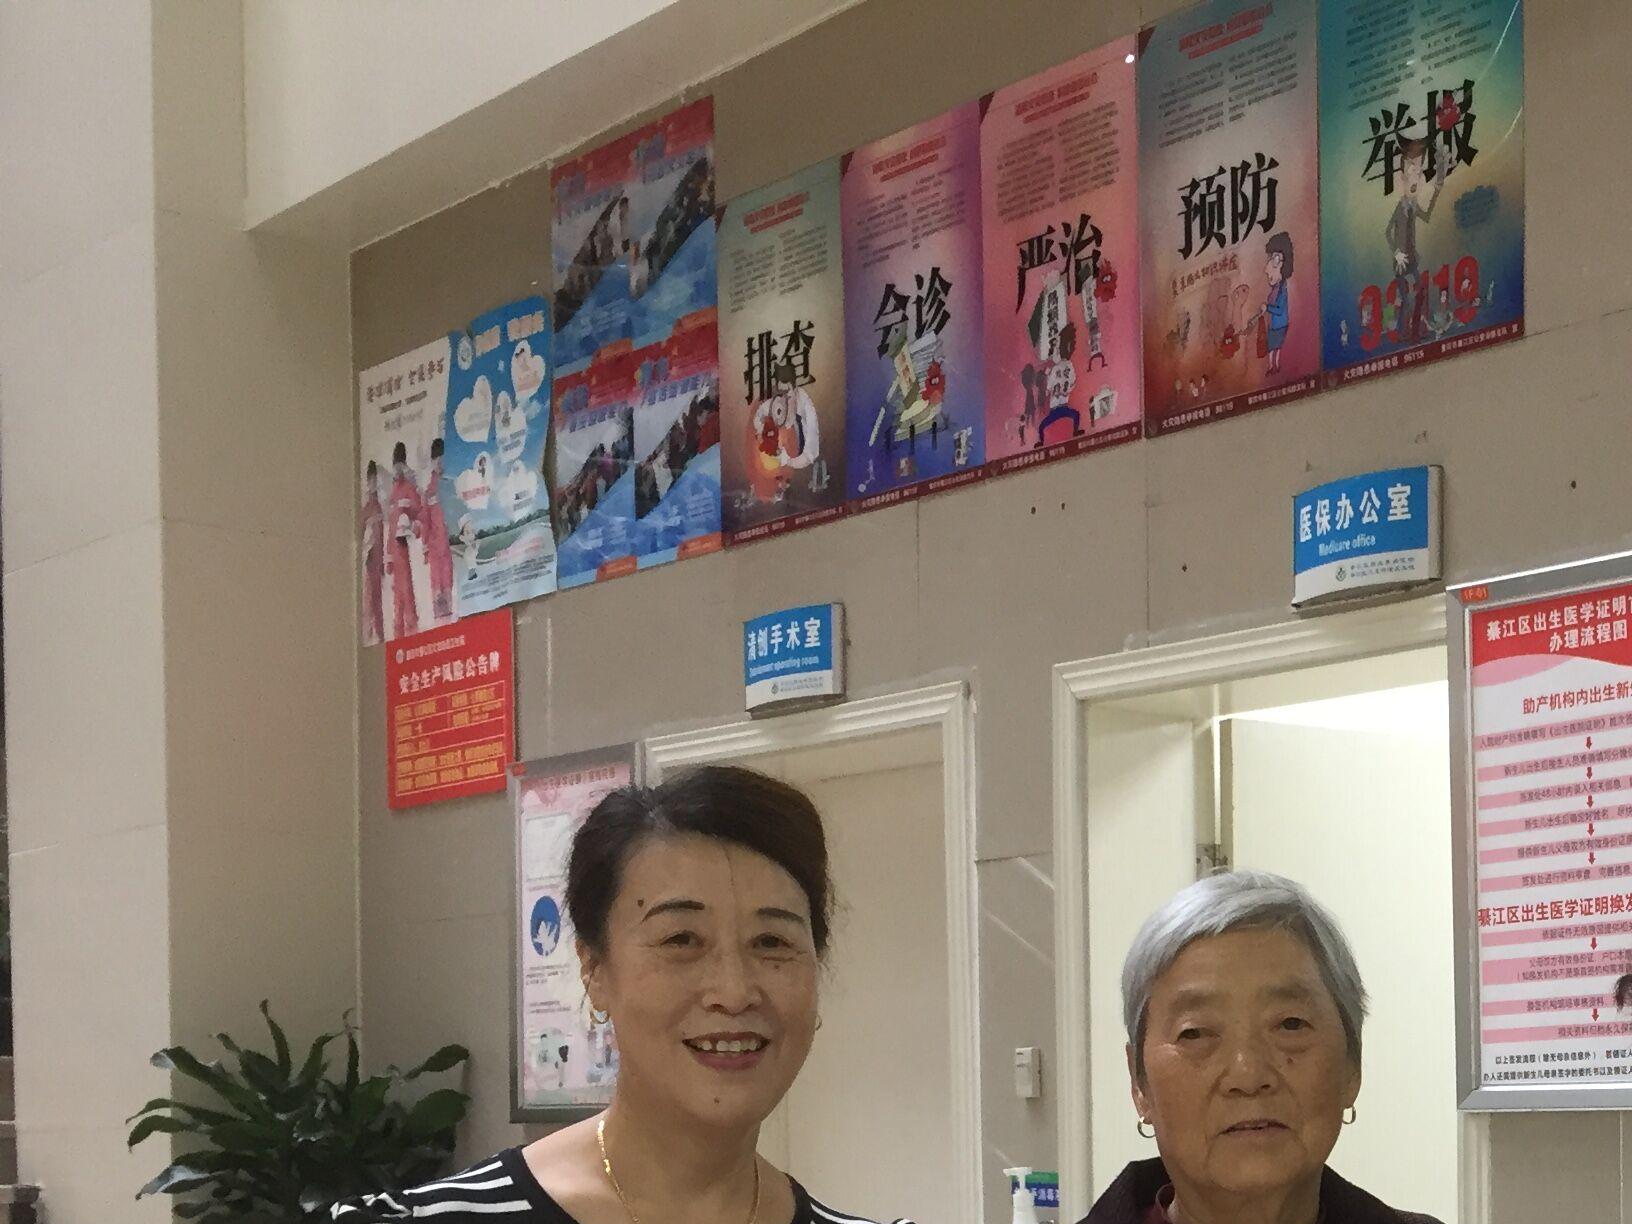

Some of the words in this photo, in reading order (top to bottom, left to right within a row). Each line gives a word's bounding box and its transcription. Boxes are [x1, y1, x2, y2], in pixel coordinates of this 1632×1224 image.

[1361, 79, 1478, 196] 举报
[1177, 152, 1279, 260] 预防
[1016, 213, 1103, 314] 严治
[873, 266, 953, 360] 会诊
[744, 320, 816, 405] 排查
[1300, 483, 1412, 543] 医保办公室
[1549, 619, 1628, 653] 办理流程图
